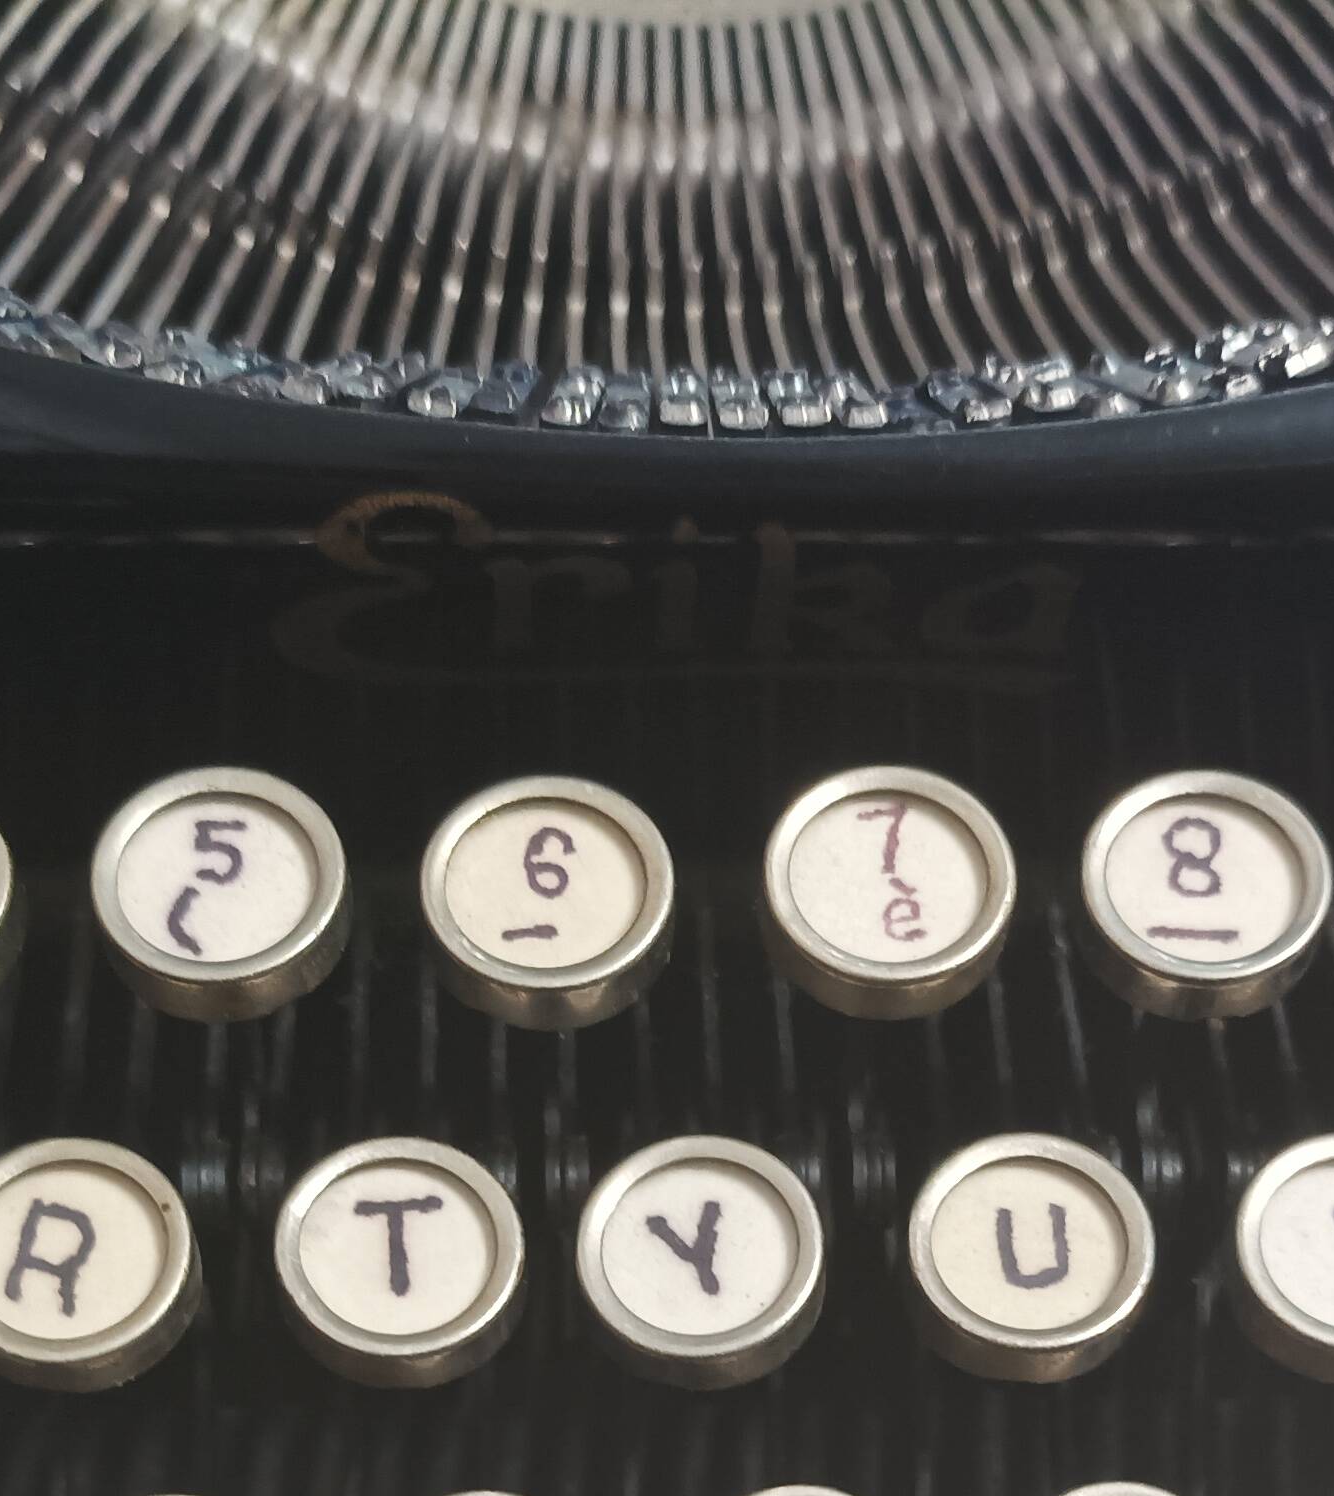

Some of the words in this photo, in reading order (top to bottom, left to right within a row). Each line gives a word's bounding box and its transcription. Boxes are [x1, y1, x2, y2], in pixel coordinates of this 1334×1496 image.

[270, 490, 1081, 692] Erika
[194, 820, 247, 885] 5
[523, 827, 576, 899] 6
[856, 804, 907, 874] 7
[1162, 816, 1222, 897] 8
[167, 886, 202, 956] (
[4, 1198, 96, 1317] R
[353, 1195, 443, 1297] T
[645, 1201, 722, 1296] Y
[996, 1203, 1070, 1290] U
